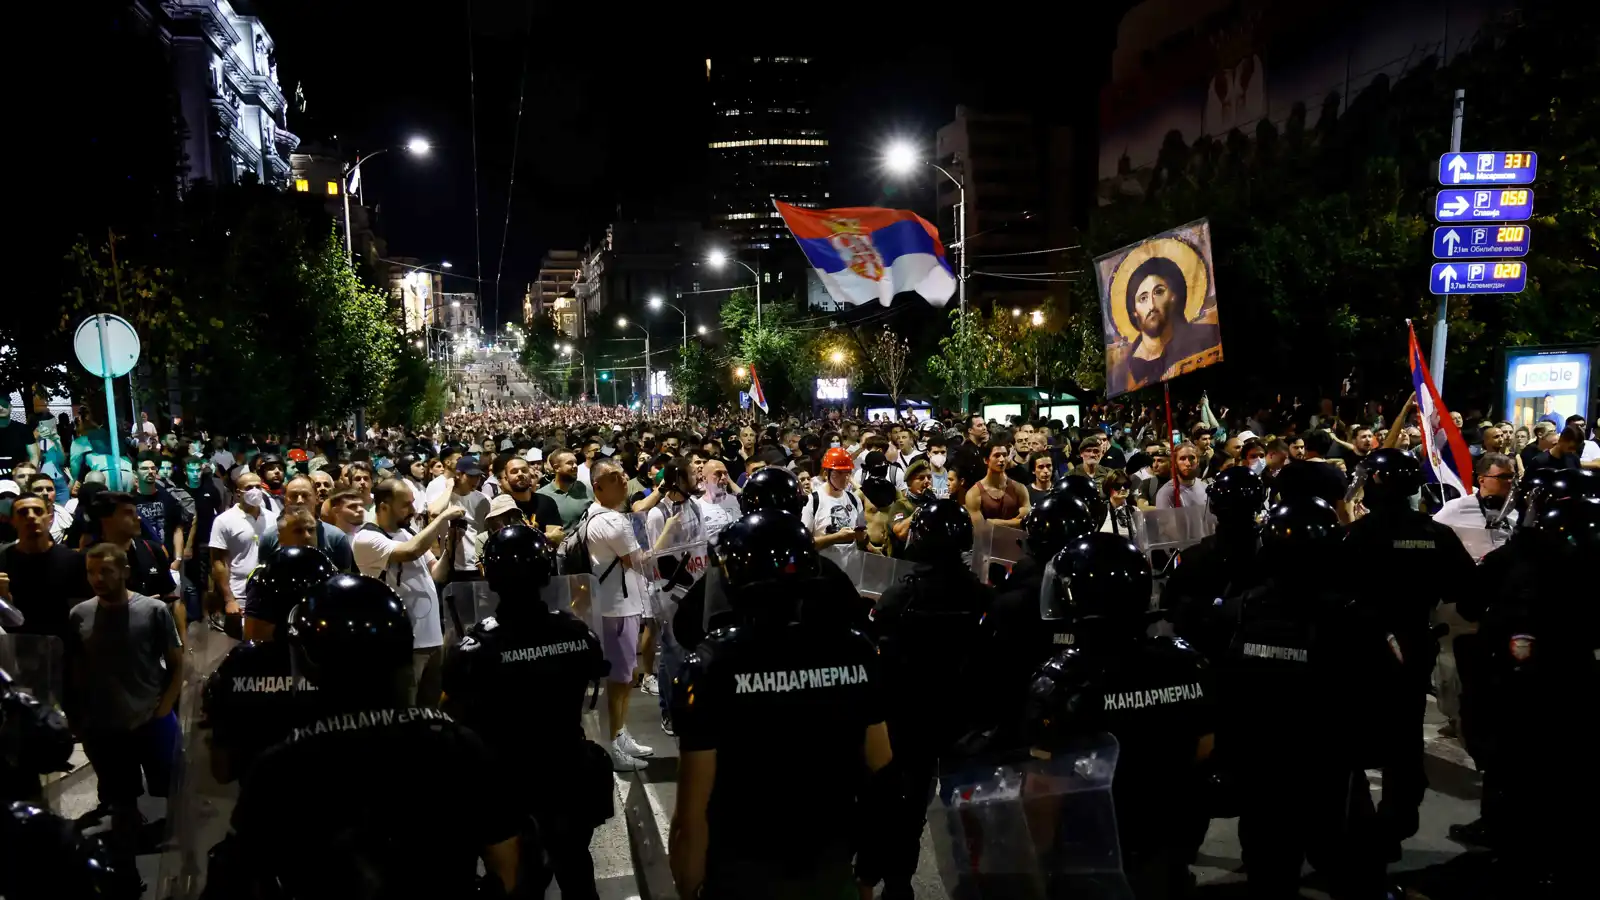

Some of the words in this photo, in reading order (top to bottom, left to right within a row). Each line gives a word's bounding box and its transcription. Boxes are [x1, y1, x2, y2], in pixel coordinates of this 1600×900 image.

[1504, 154, 1531, 168] 331
[1477, 192, 1488, 207] P
[1497, 227, 1525, 242] 200
[1471, 265, 1482, 279] P
[1493, 264, 1521, 278] 020
[1522, 365, 1573, 387] jooble
[500, 639, 590, 663] ЖАНДАРМЕРИЈА
[734, 664, 869, 694] ЖАНДАРМЕРИЈА
[1104, 682, 1204, 711] ЖАНДАРМЕРИЈА
